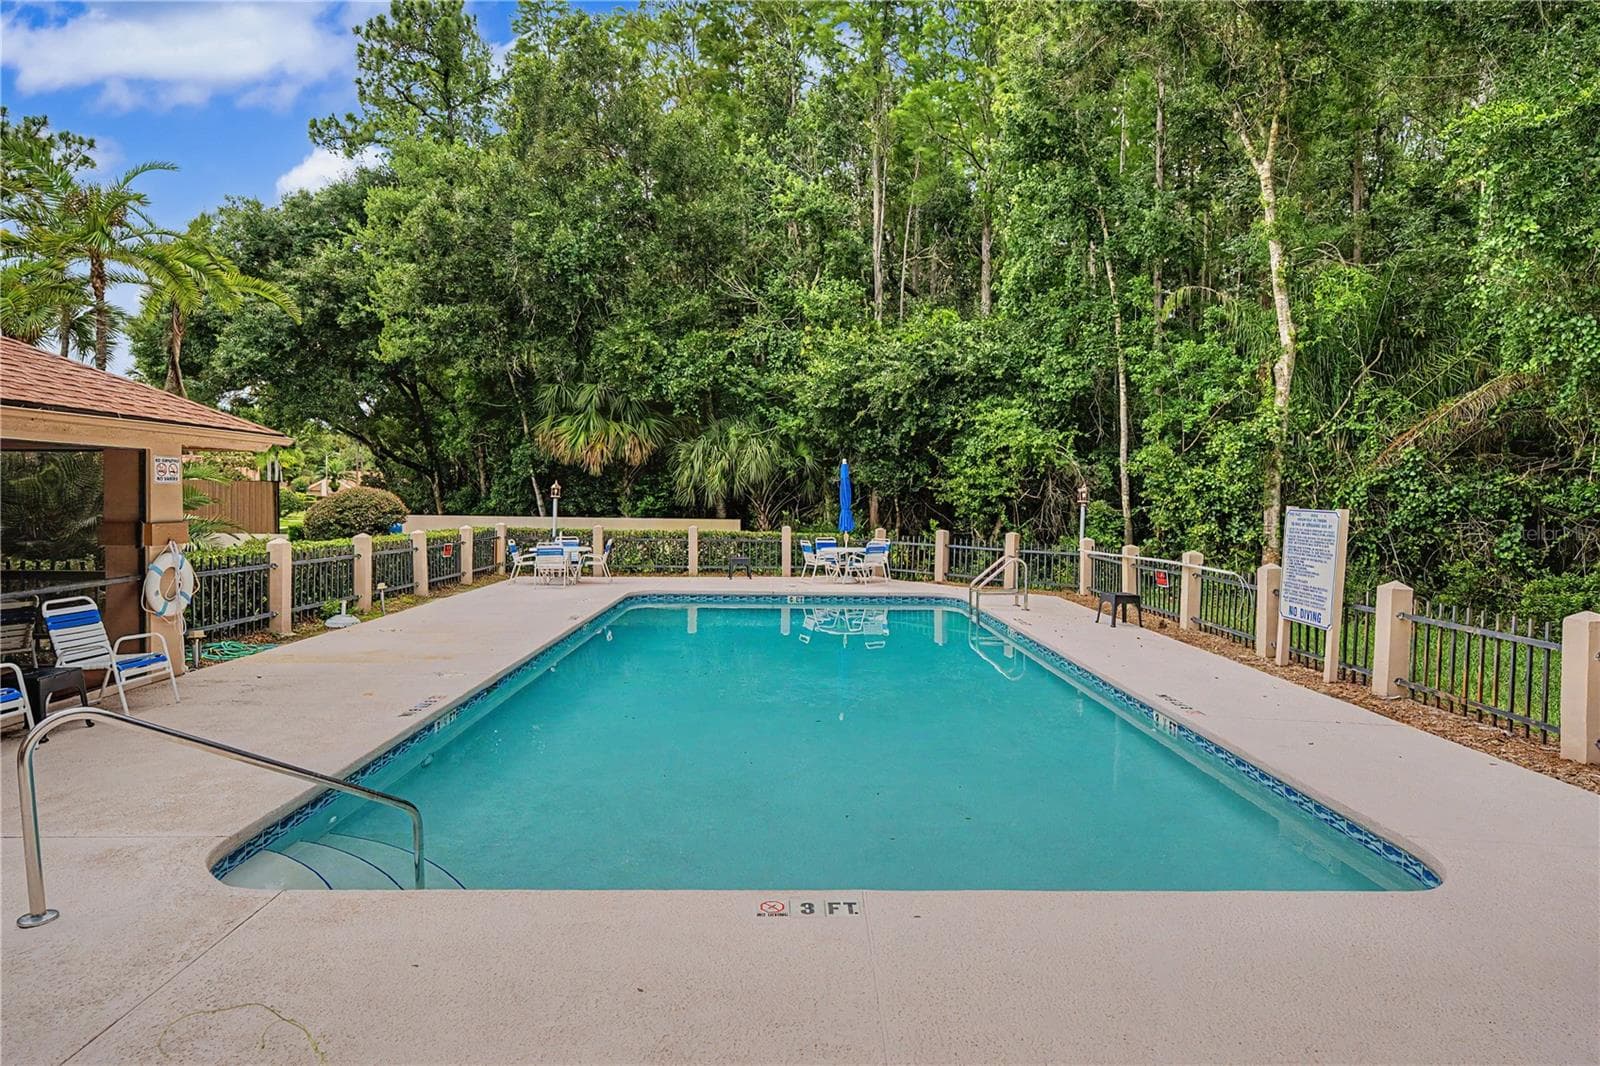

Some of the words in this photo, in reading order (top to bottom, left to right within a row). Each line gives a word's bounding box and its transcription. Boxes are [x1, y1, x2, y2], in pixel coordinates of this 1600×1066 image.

[1289, 605, 1297, 617] NO
[1300, 608, 1321, 623] DIVING
[800, 902, 815, 915] 3
[828, 902, 859, 914] FT.
